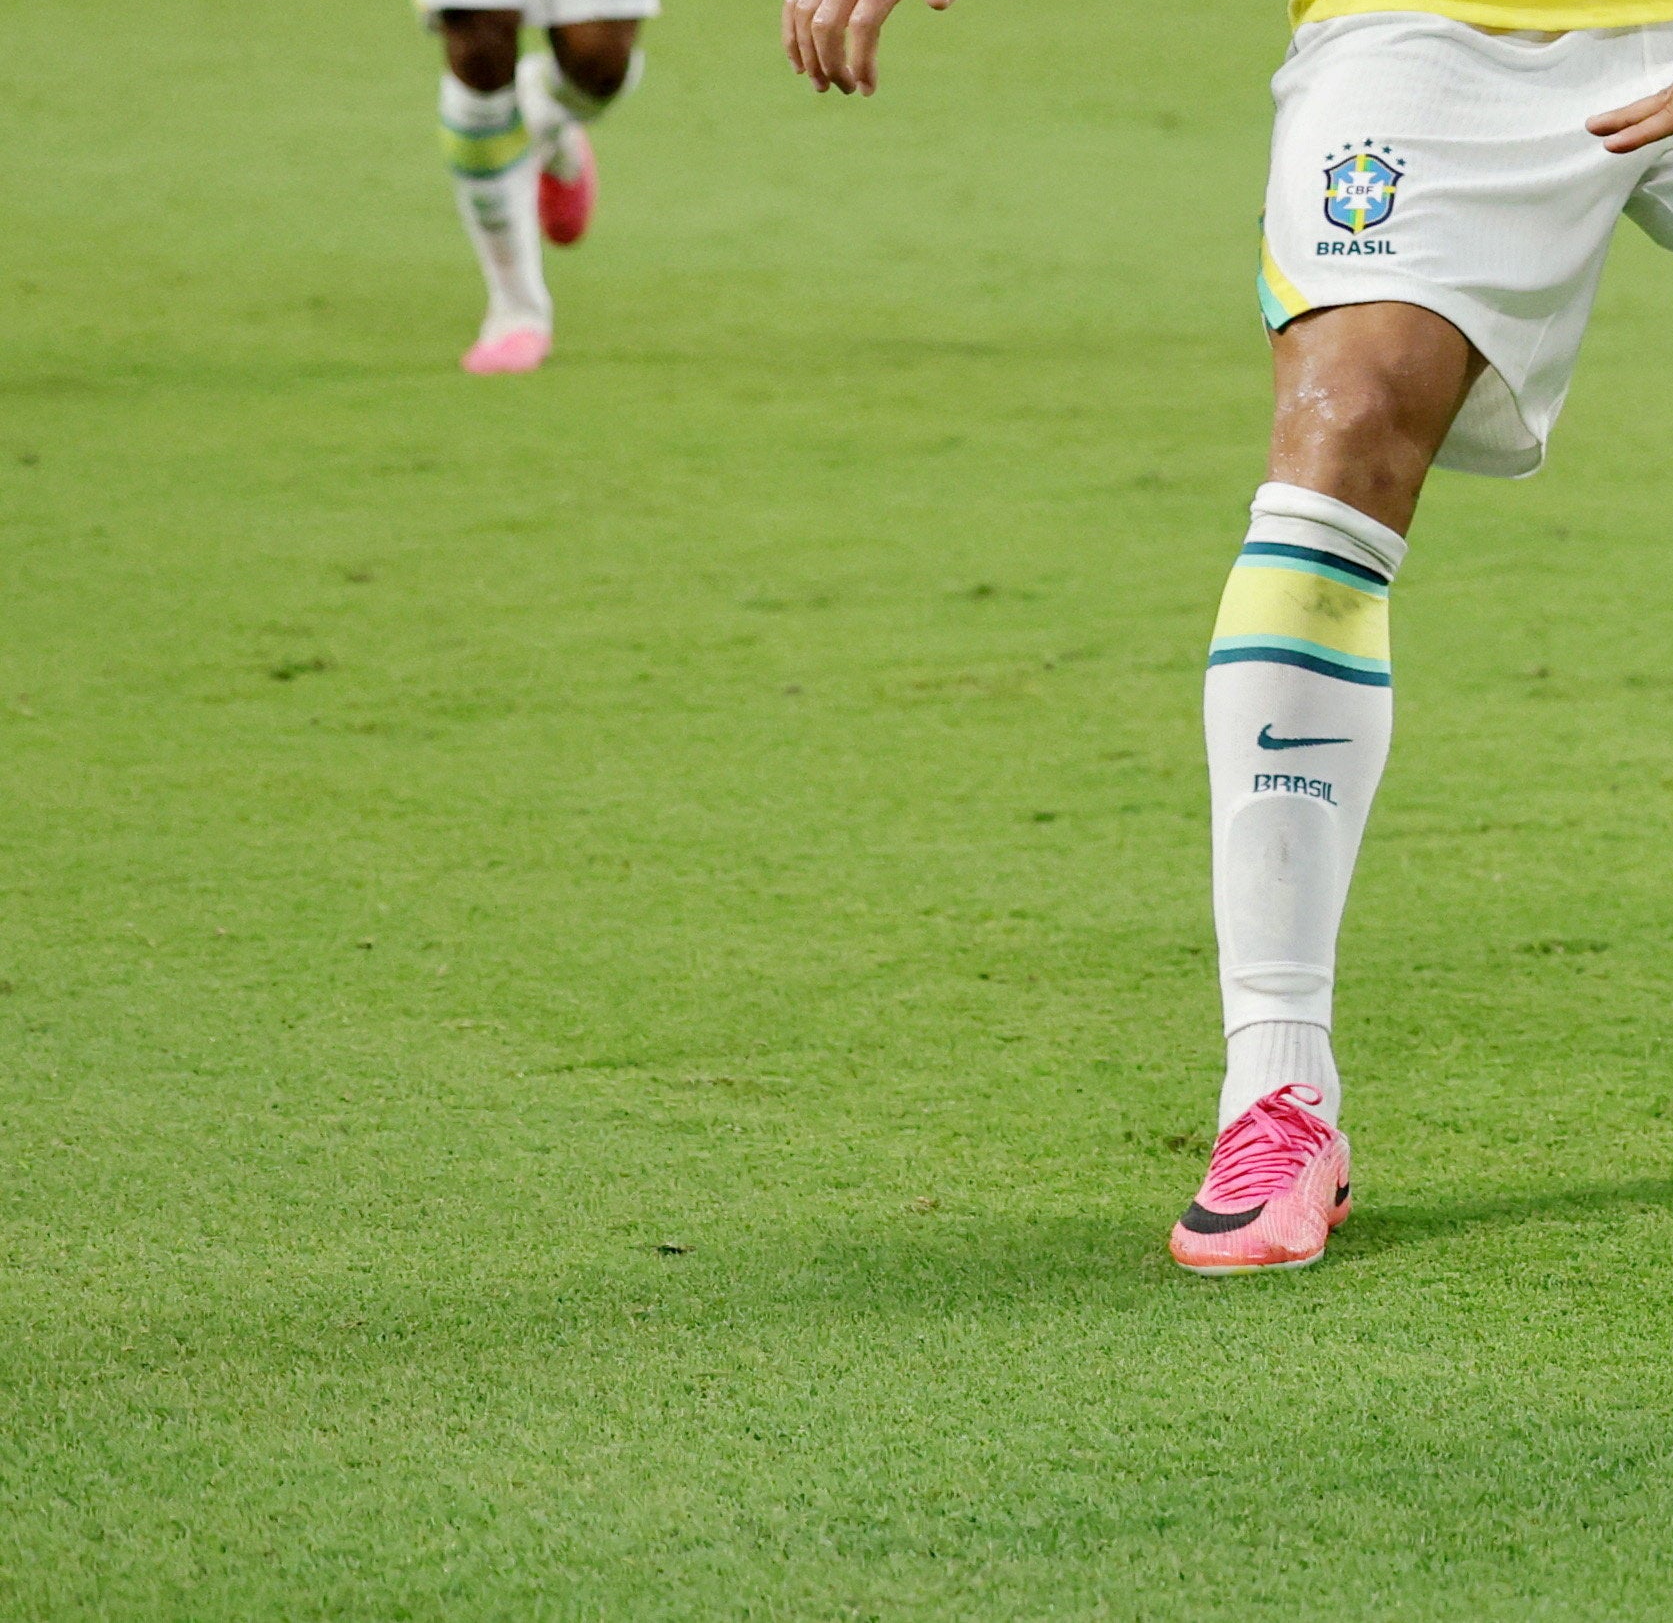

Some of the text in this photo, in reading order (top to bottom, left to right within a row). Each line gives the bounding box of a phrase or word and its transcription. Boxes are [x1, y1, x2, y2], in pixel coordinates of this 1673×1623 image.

[1346, 184, 1375, 196] CBF
[1316, 239, 1398, 256] BRASIL
[1253, 773, 1338, 807] BRASIL
